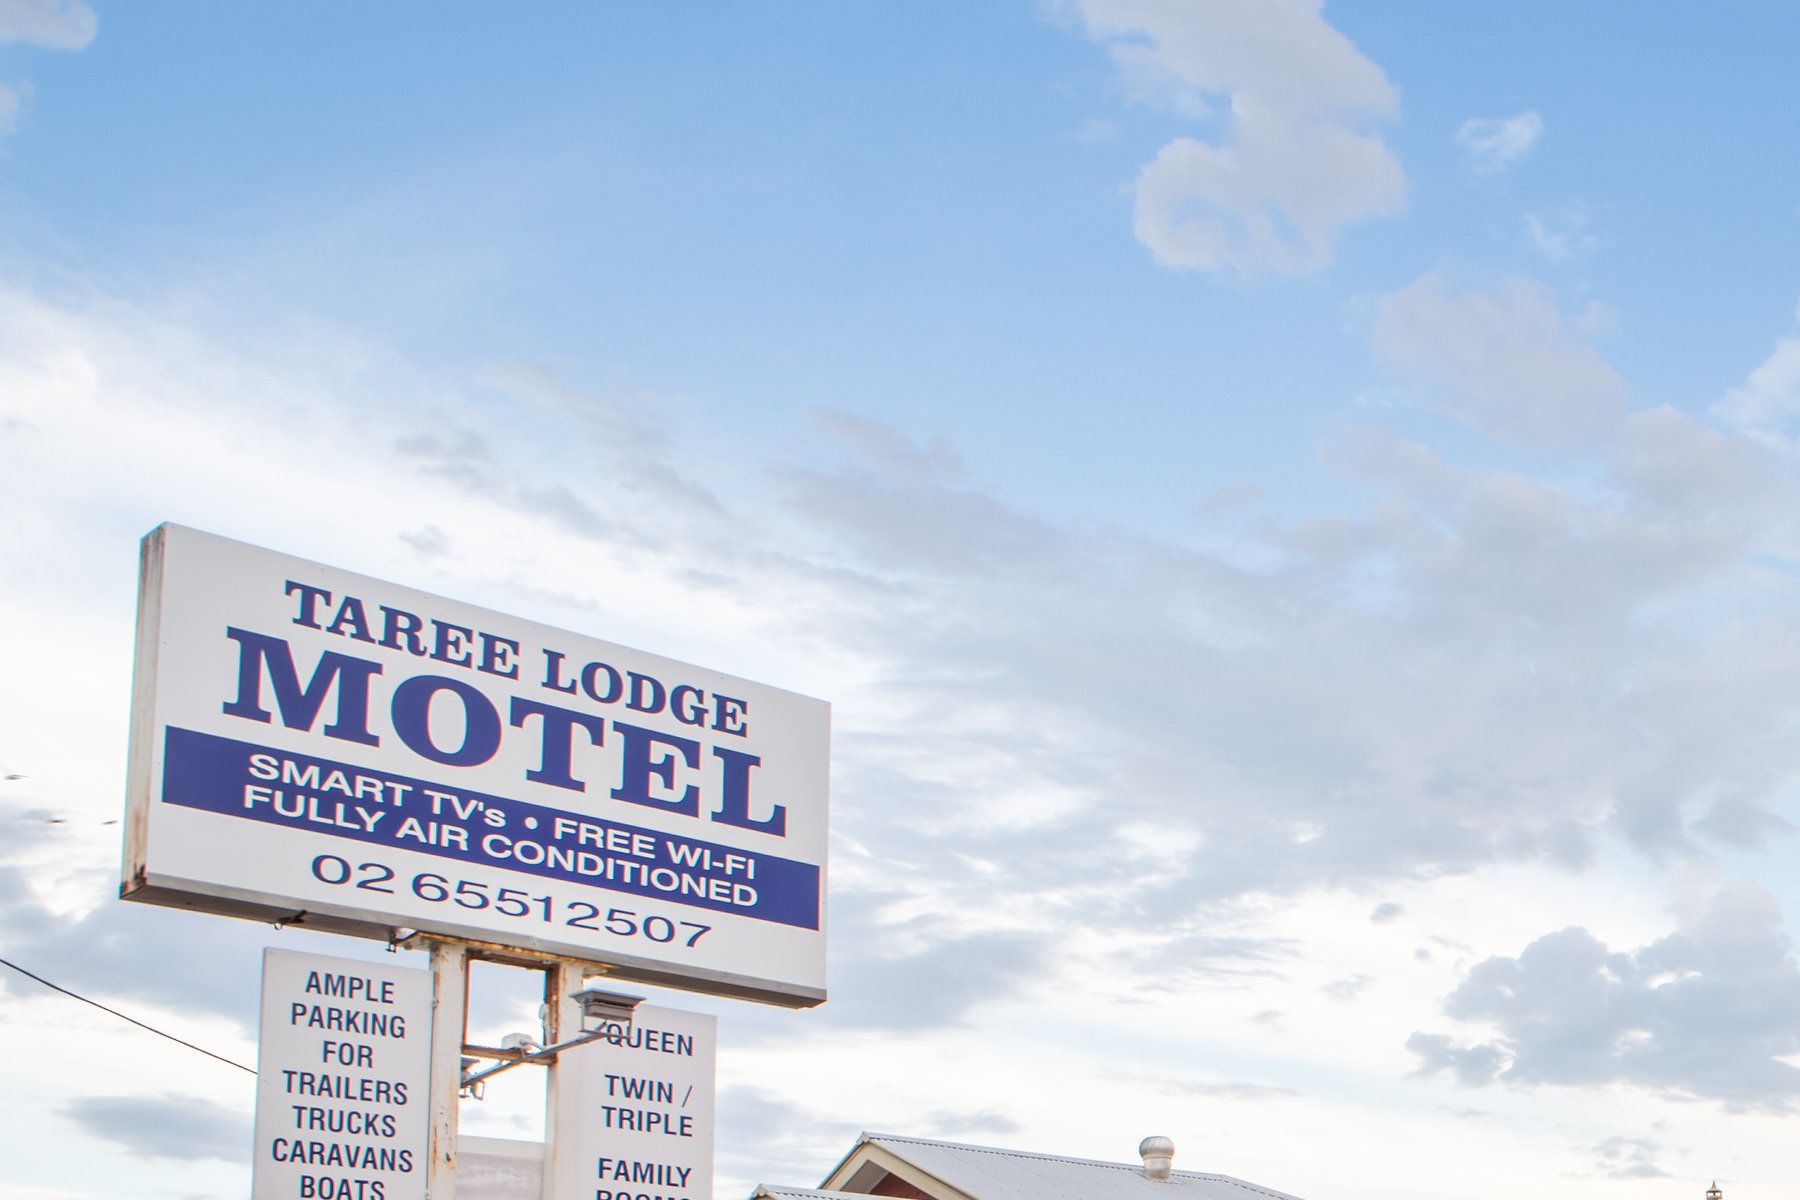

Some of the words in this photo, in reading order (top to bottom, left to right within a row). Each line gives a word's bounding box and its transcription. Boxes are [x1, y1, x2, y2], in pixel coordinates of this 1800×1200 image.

[284, 579, 520, 681] TAREE
[541, 648, 748, 739] LODGE
[222, 625, 787, 838] MOTEL
[247, 754, 413, 809] SMART
[423, 789, 506, 829] TV's
[554, 817, 656, 859] FREE
[666, 841, 755, 880] WI-FI
[244, 784, 384, 832] FULLY
[395, 816, 469, 852] AIR
[482, 833, 758, 907] CONDITIONED
[311, 854, 395, 894] 02
[305, 970, 395, 1005] AMPLE
[291, 1002, 406, 1039] PARKING
[322, 1040, 373, 1069] FOR
[606, 1023, 693, 1057] QUEEN
[282, 1069, 408, 1106] TRAILERS
[604, 1074, 673, 1104] TWIN
[292, 1104, 396, 1138] TRUCKS
[601, 1105, 693, 1138] TRIPLE
[272, 1137, 413, 1173] CARAVANS
[598, 1157, 692, 1188] FAMILY
